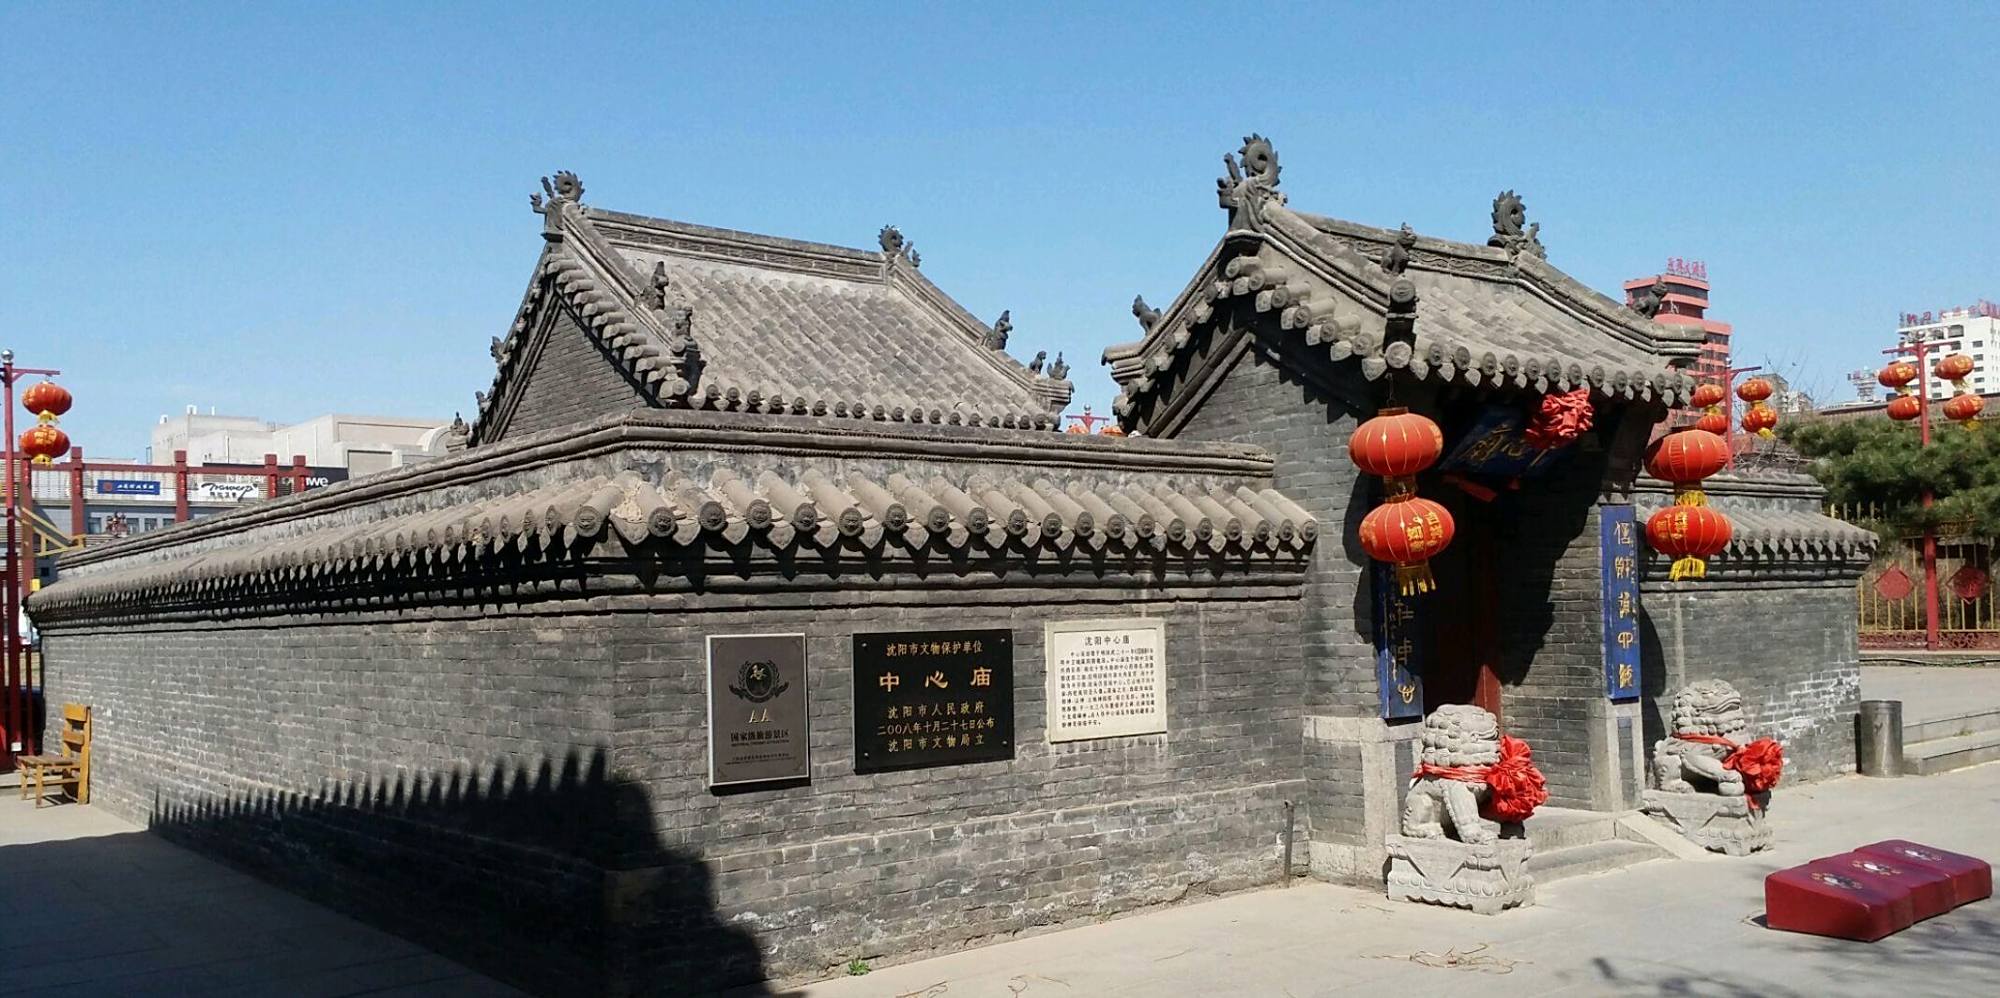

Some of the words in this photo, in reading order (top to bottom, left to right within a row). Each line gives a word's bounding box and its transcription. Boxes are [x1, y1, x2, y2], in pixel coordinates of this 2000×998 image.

[886, 640, 983, 657] 沈阳市文物保护单位
[879, 666, 993, 693] 中心庙
[887, 700, 985, 719] 沈阳市人民政府
[888, 733, 985, 753] 沈阳市文物局立
